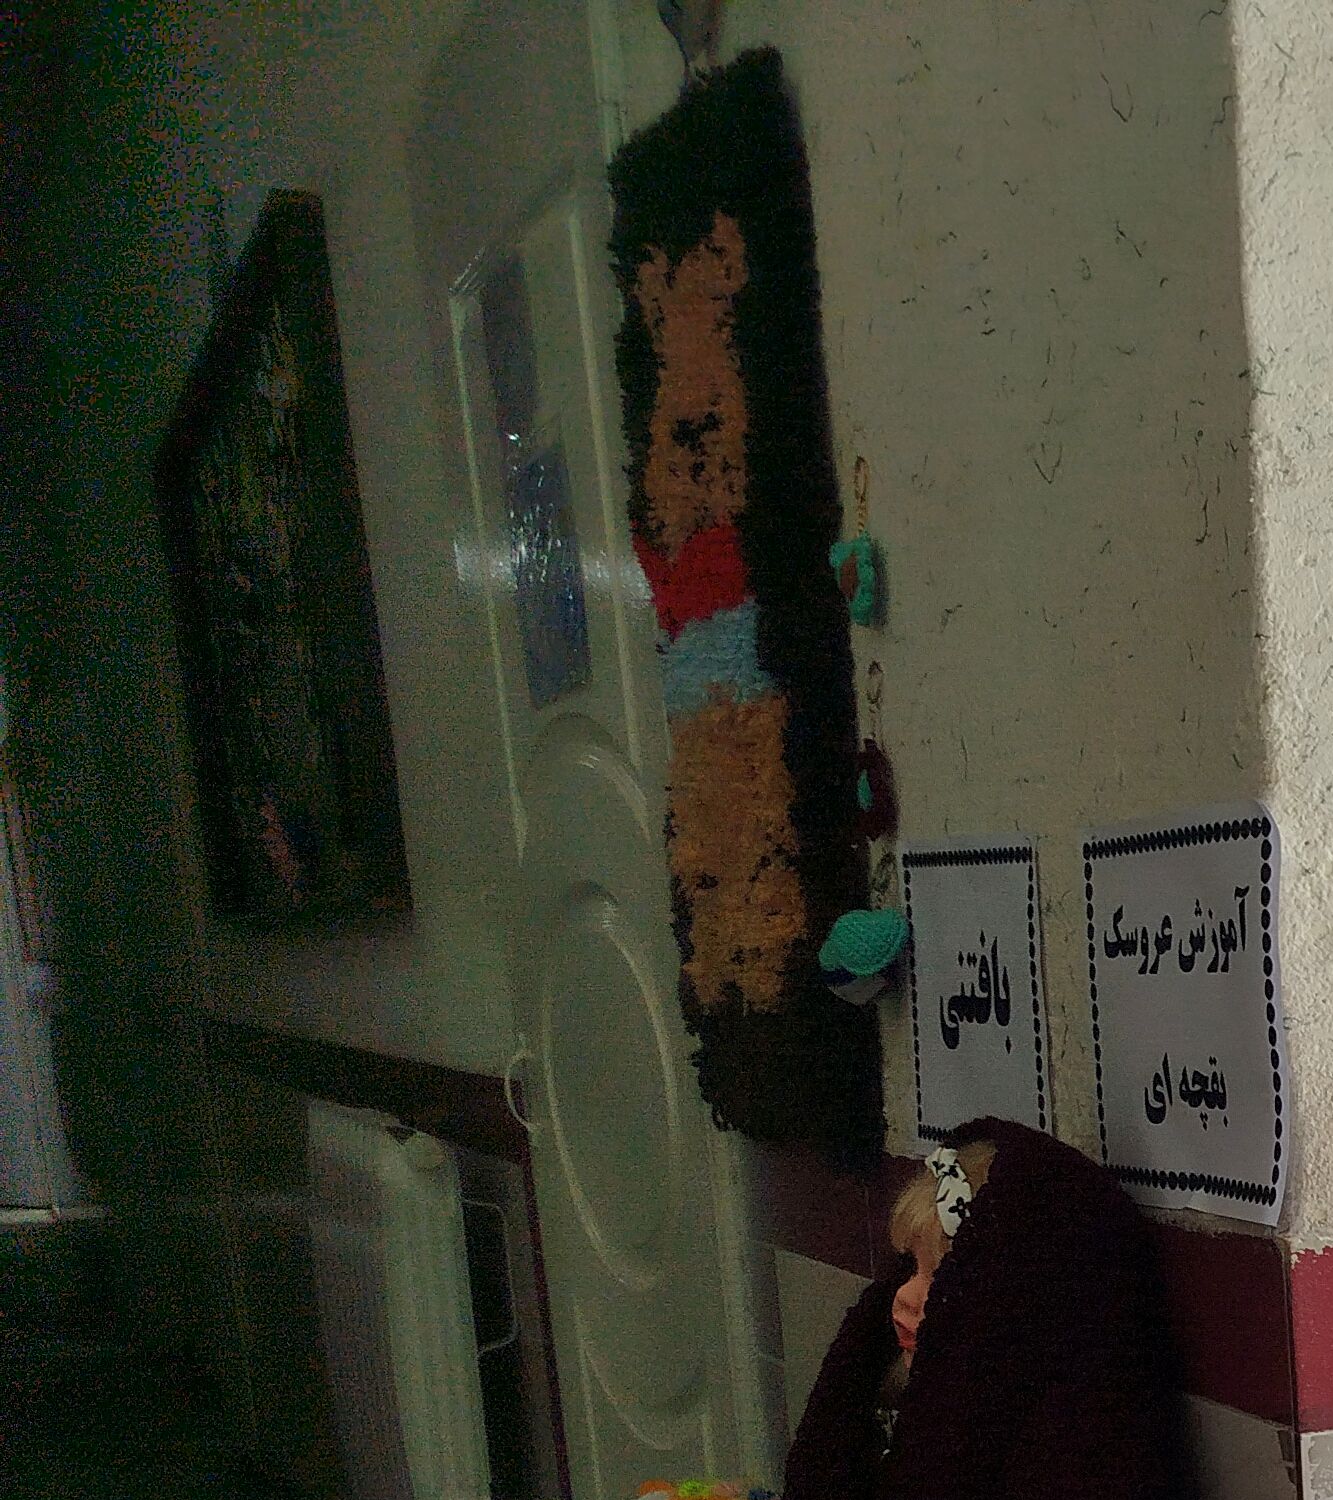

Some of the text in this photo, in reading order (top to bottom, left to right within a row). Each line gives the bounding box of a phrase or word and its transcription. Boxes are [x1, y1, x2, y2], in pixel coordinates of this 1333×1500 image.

[1104, 886, 1250, 974] آموزش عروسک
[940, 930, 1011, 1054] بافتنی
